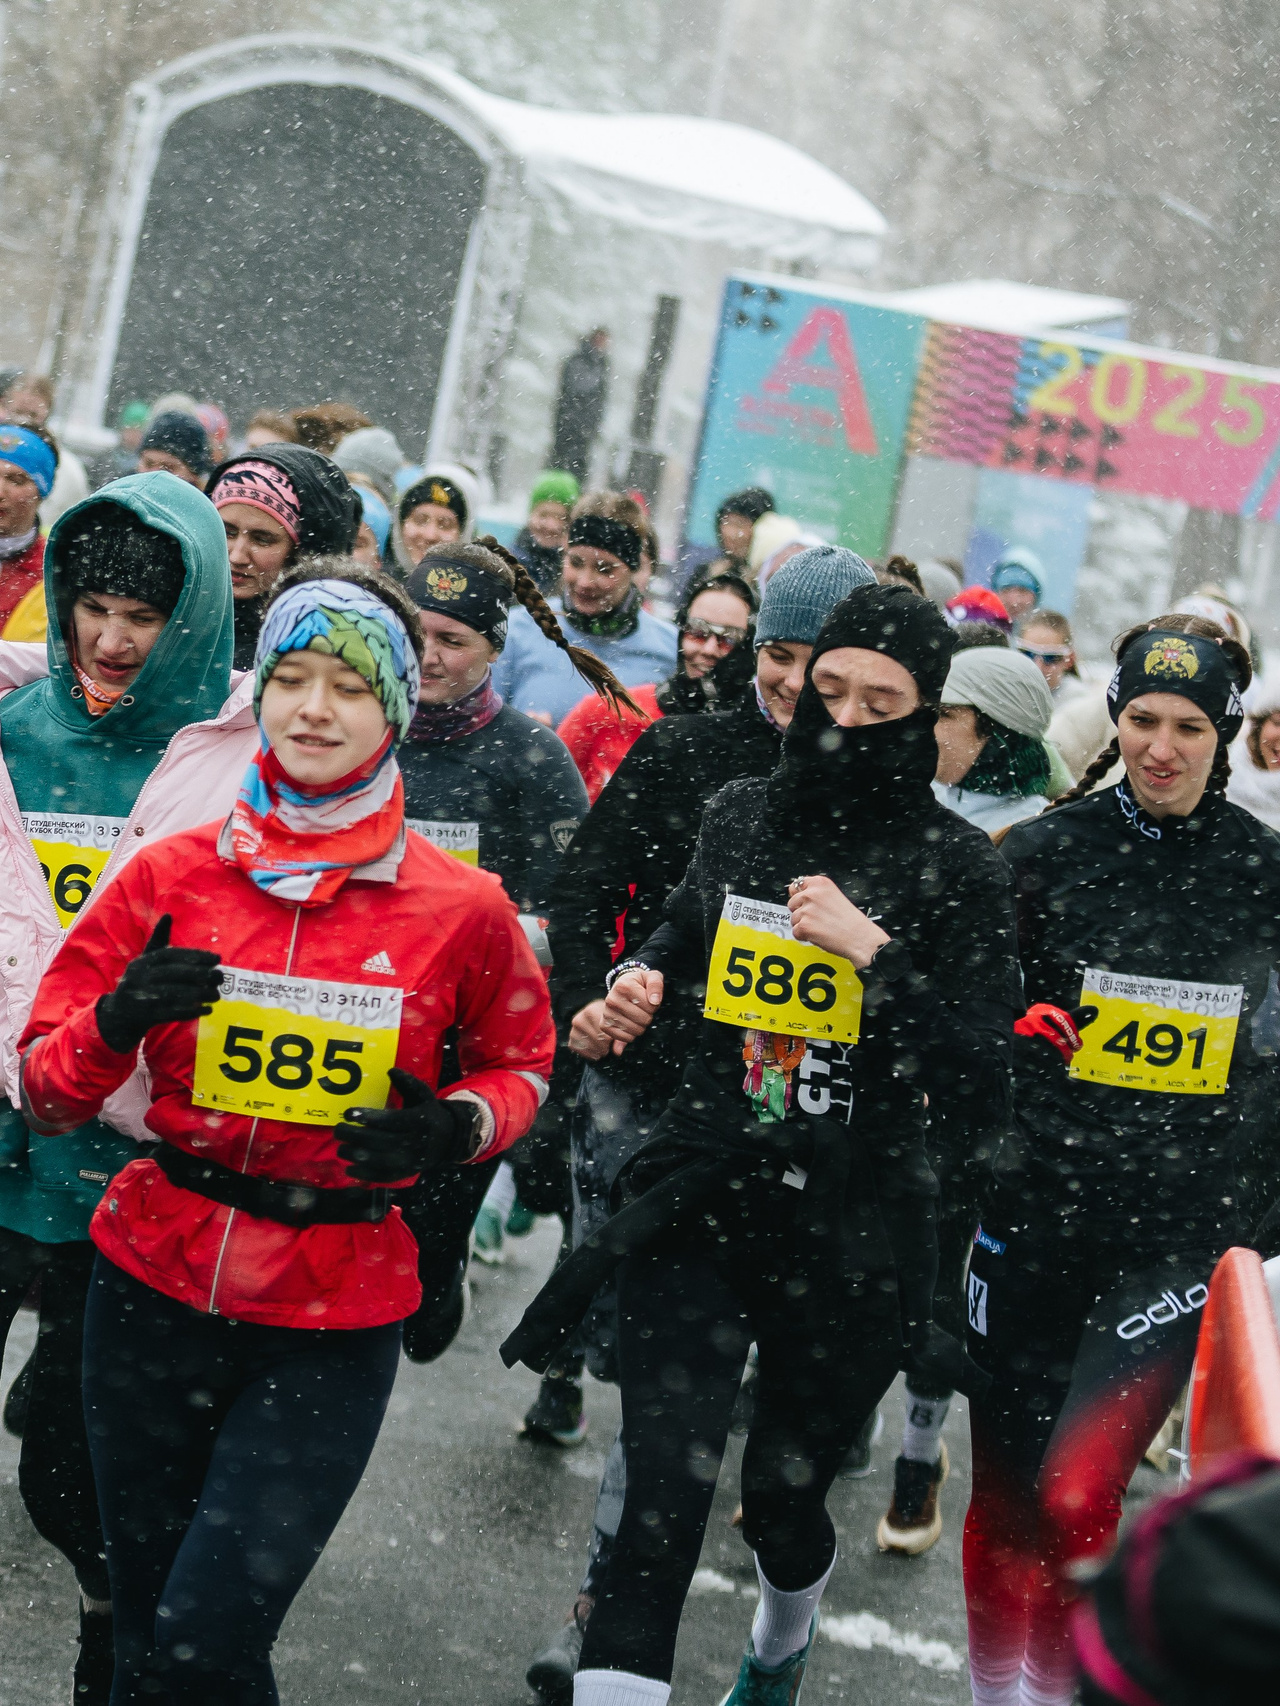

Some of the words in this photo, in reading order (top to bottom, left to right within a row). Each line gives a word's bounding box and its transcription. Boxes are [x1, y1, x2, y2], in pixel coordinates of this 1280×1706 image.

[1031, 341, 1269, 448] 2025
[29, 827, 52, 835] КУБОК
[30, 819, 85, 829] СТУДЕНЧЕСКИЙ
[96, 825, 105, 836] 3
[424, 828, 431, 837] 3
[436, 829, 467, 838] ЭТАП
[740, 913, 761, 923] КУБОК
[742, 906, 791, 922] СТУДЕНЧЕСКИЙ
[361, 962, 396, 976] adidas
[722, 946, 838, 1013] 586
[236, 986, 264, 997] КУБОК
[237, 978, 307, 994] СТУДЕНЧЕСКИЙ
[320, 992, 329, 1003] 3
[337, 994, 381, 1009] ЭТАП
[1113, 987, 1138, 996] КУБОК
[1115, 980, 1172, 993] СТУДЕНЧЕСКИЙ
[1181, 990, 1189, 999] 3
[1194, 991, 1230, 1003] ЭТАП
[1101, 1020, 1208, 1070] 491
[217, 1024, 364, 1096] 585
[1116, 1282, 1209, 1340] odlo
